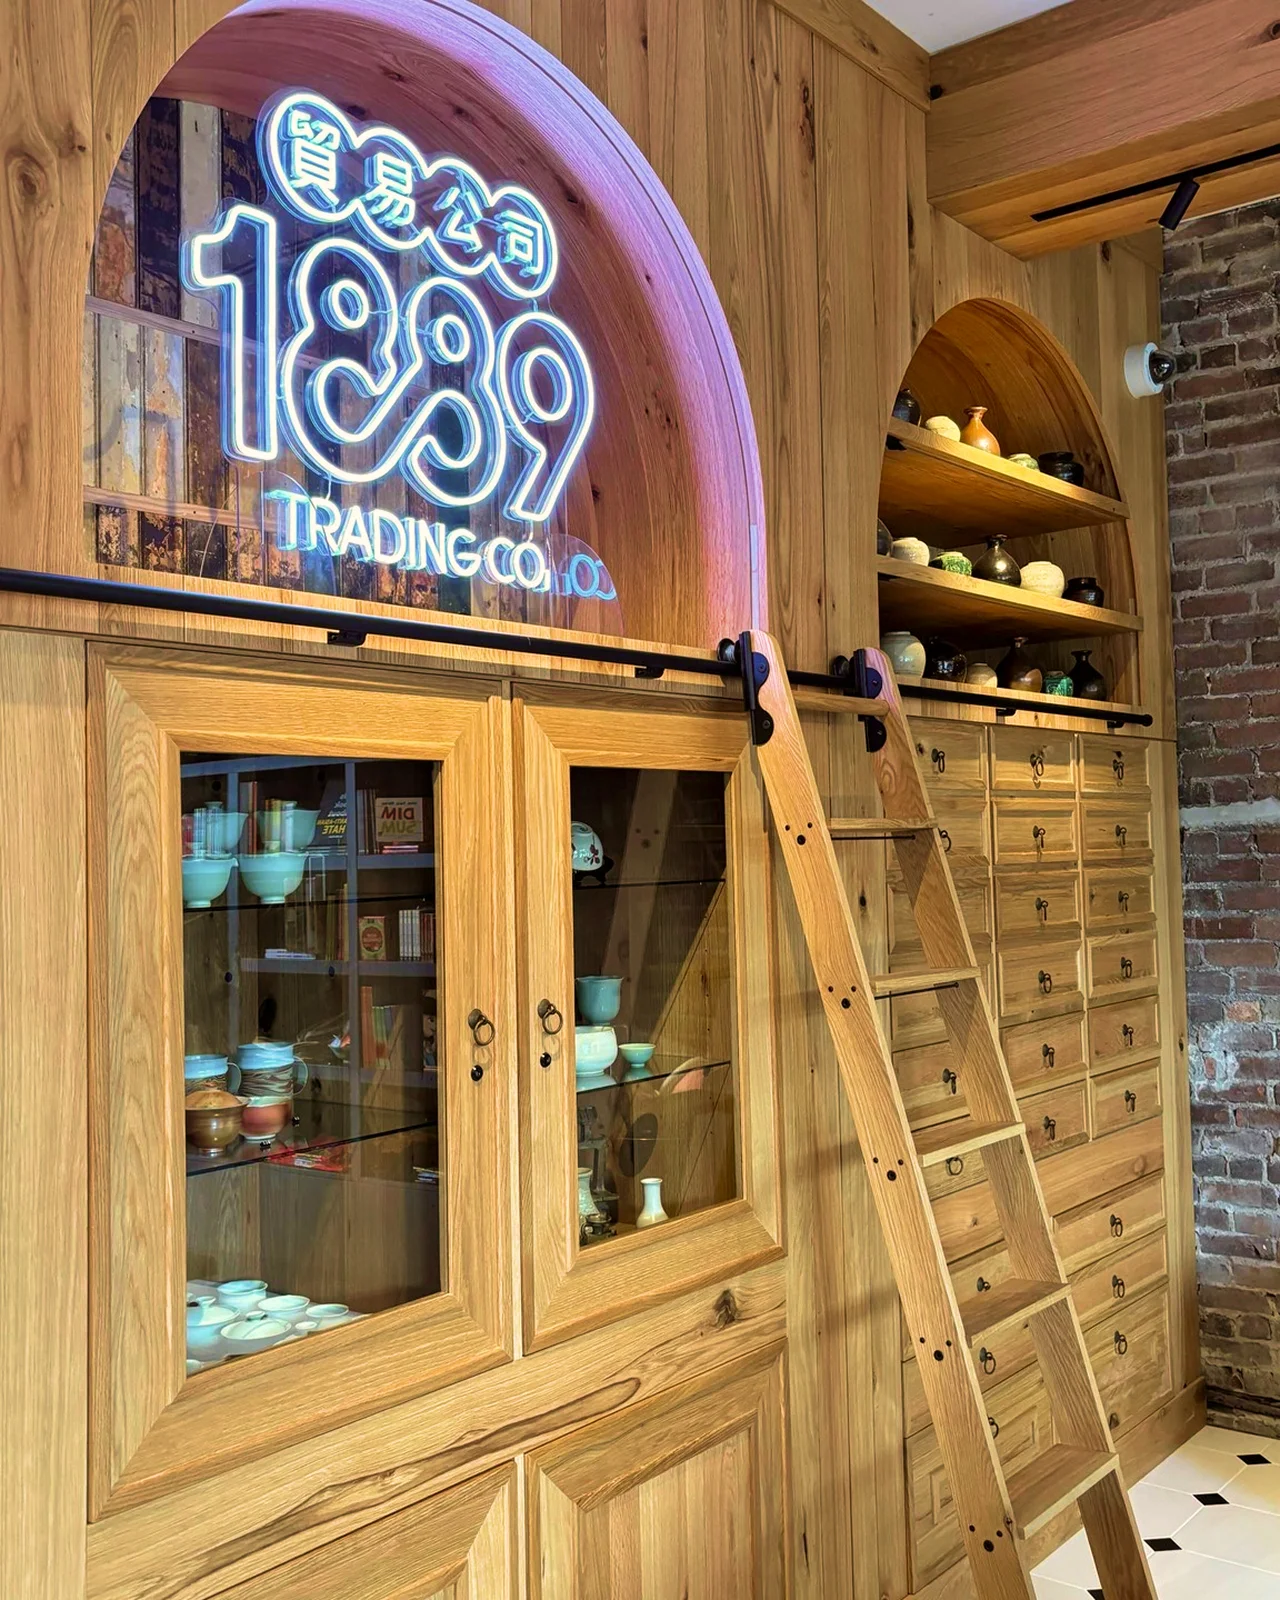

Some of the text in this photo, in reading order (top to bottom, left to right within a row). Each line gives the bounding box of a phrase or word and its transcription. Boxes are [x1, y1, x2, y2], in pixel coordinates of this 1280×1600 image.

[278, 109, 545, 278] 貿易公司
[184, 204, 596, 523] 1889
[267, 489, 482, 577] TRADING
